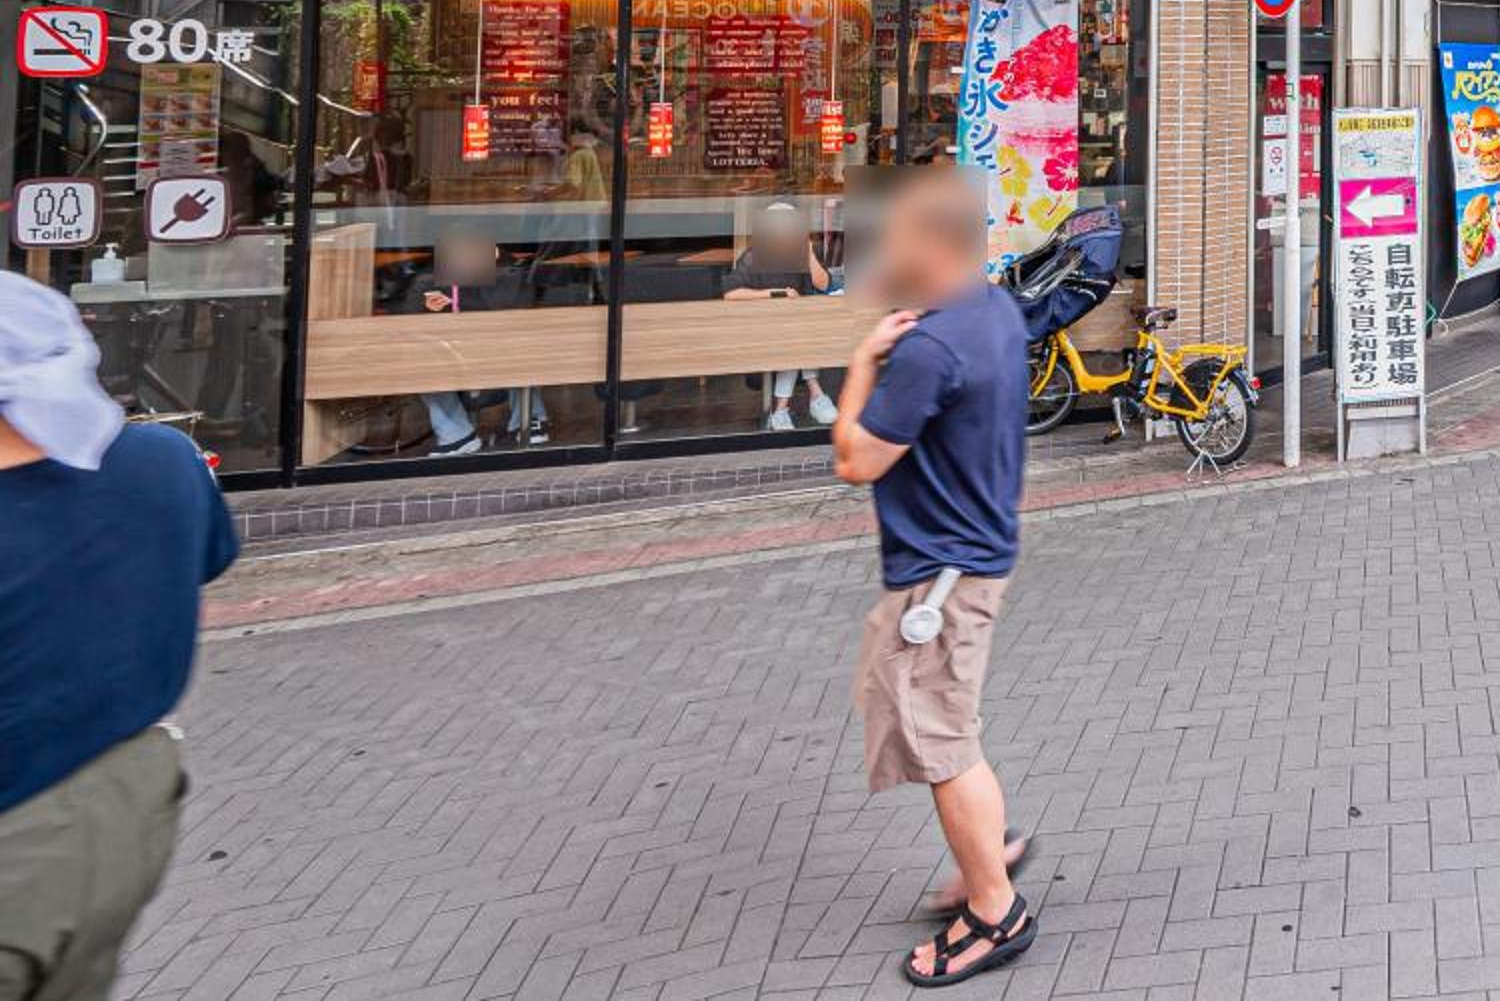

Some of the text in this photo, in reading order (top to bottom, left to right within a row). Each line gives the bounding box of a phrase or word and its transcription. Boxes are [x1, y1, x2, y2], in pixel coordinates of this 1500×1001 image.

[127, 18, 255, 63] 80席
[28, 226, 83, 242] Toilet
[1385, 243, 1418, 385] 自転車駐車場
